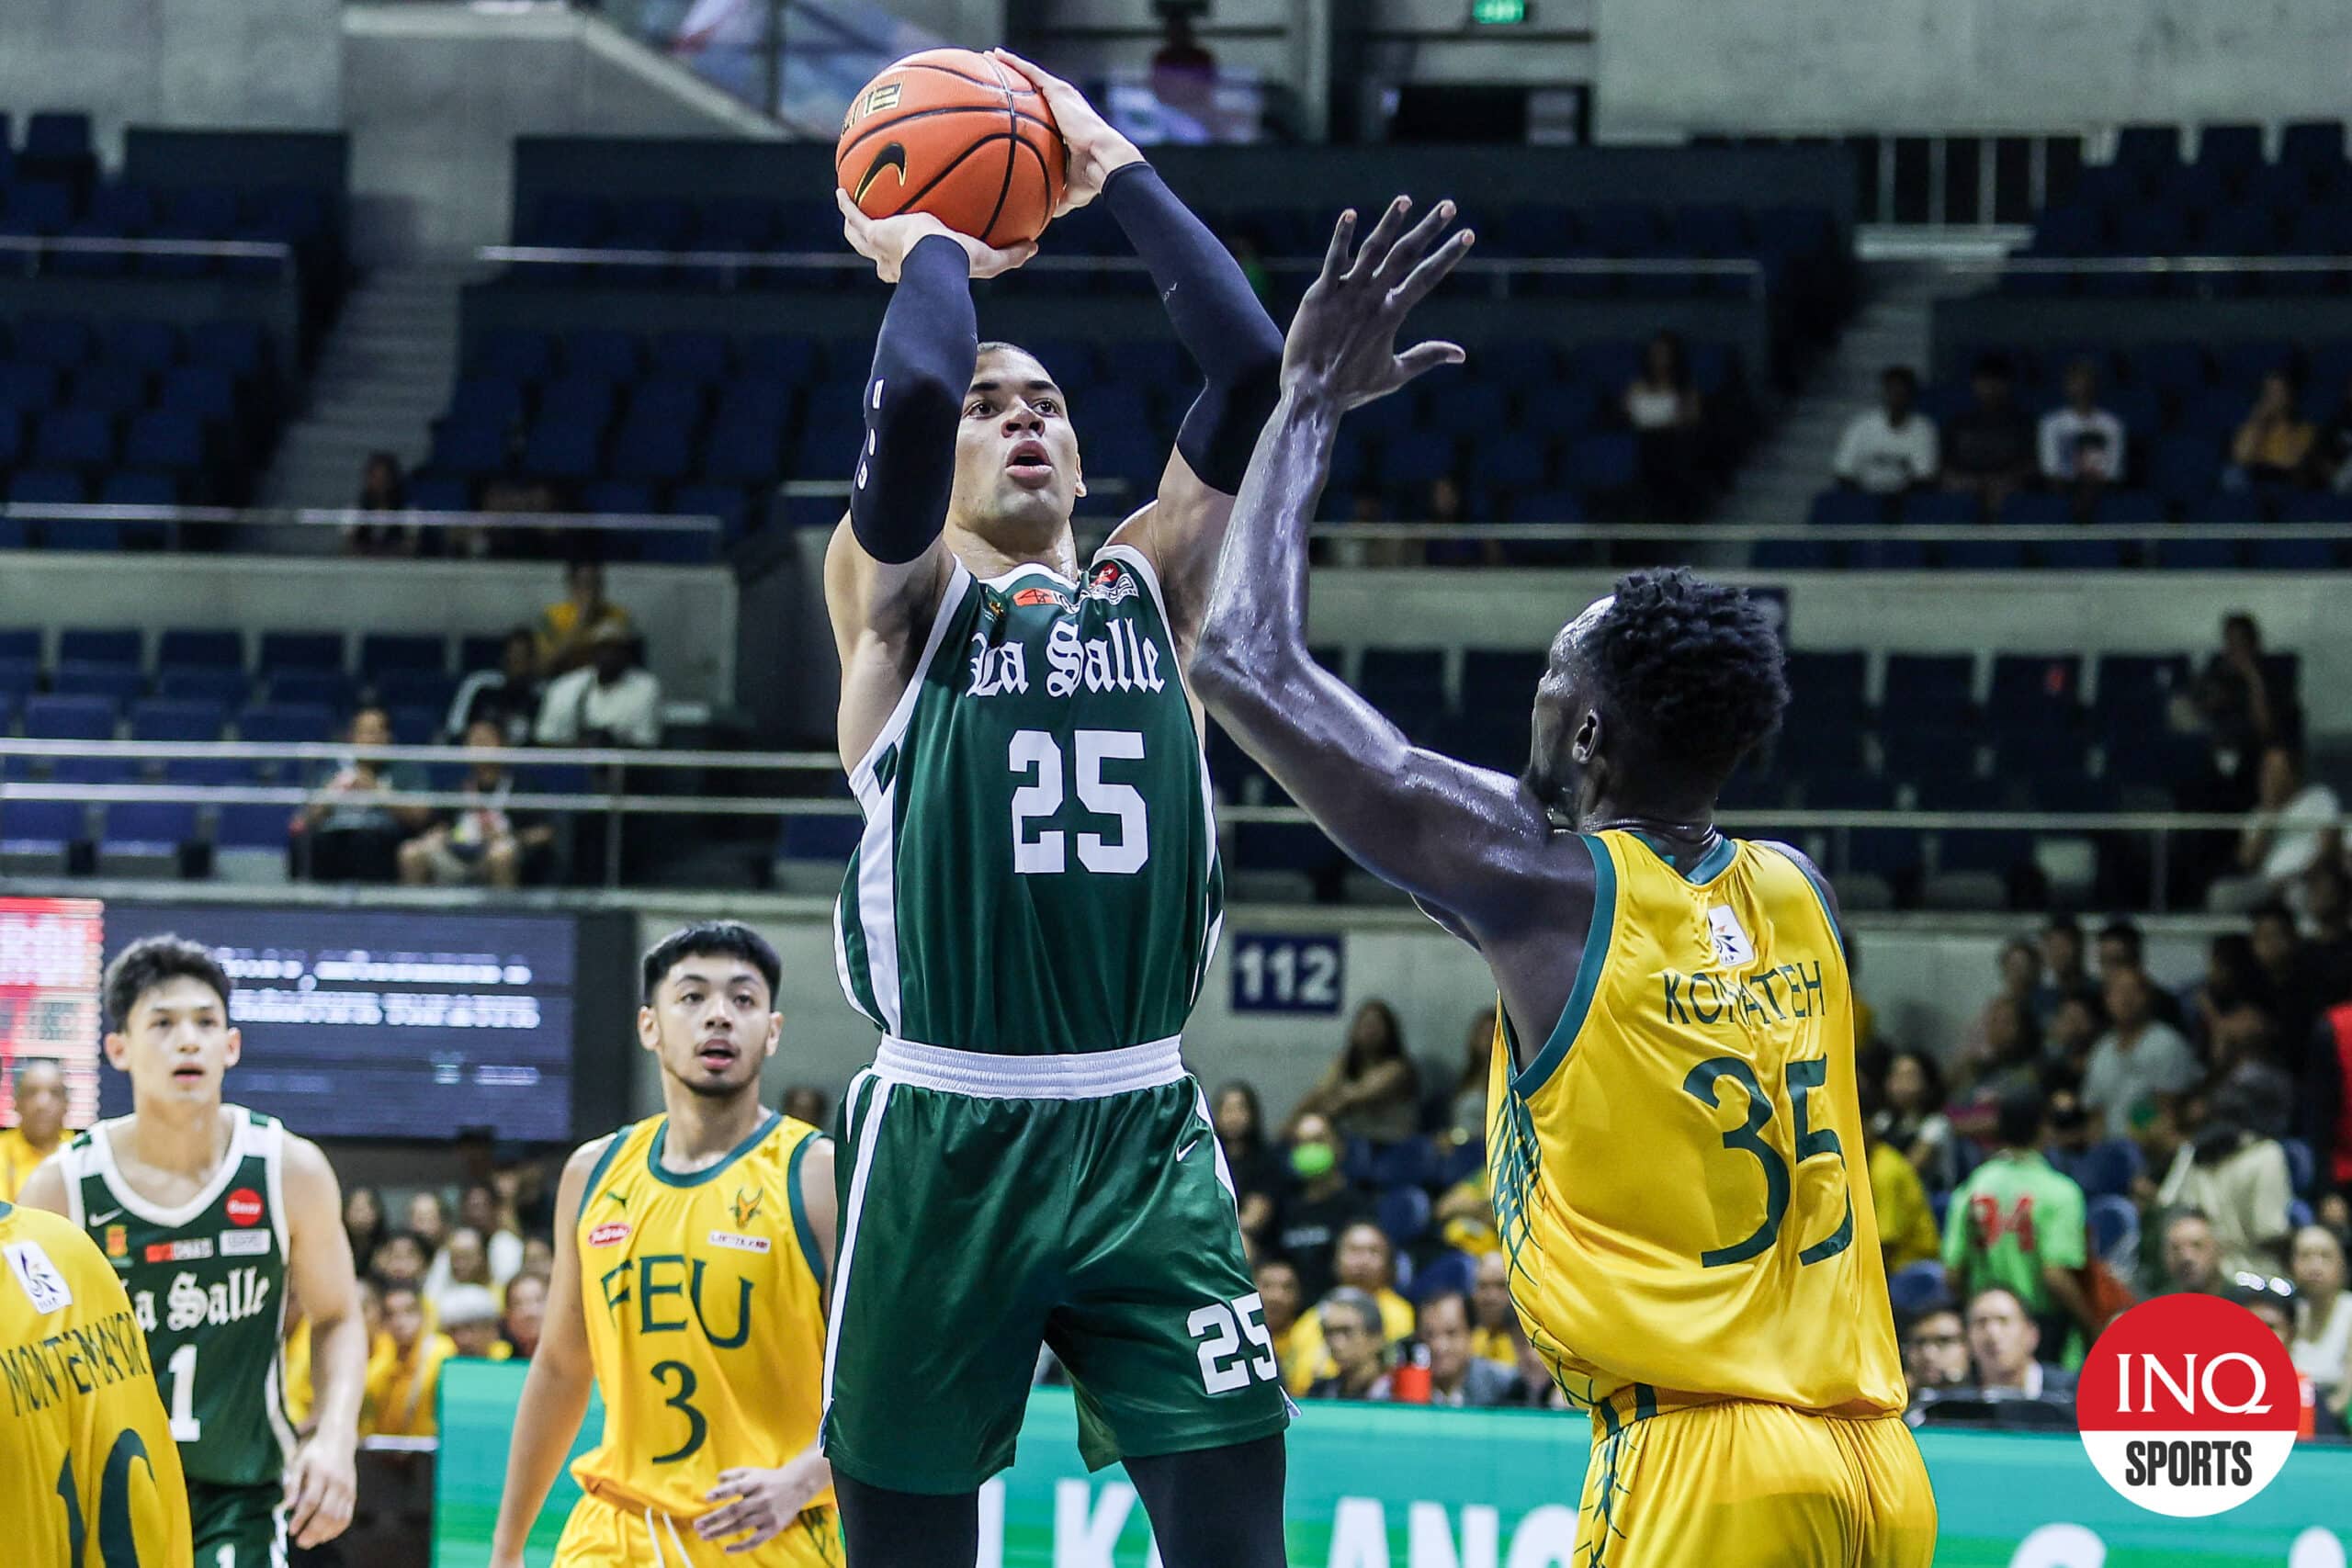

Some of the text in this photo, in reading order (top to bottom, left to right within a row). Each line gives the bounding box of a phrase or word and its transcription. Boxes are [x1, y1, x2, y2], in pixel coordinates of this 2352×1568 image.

[966, 618, 1165, 698] La Salle
[1008, 729, 1149, 874] 25
[1238, 943, 1338, 1003] 112
[1683, 1052, 1853, 1269] 35
[166, 1265, 269, 1332] Salle
[600, 1255, 755, 1349] FEU
[1186, 1292, 1278, 1394] 25
[168, 1344, 201, 1442] 1
[650, 1359, 708, 1465] 3
